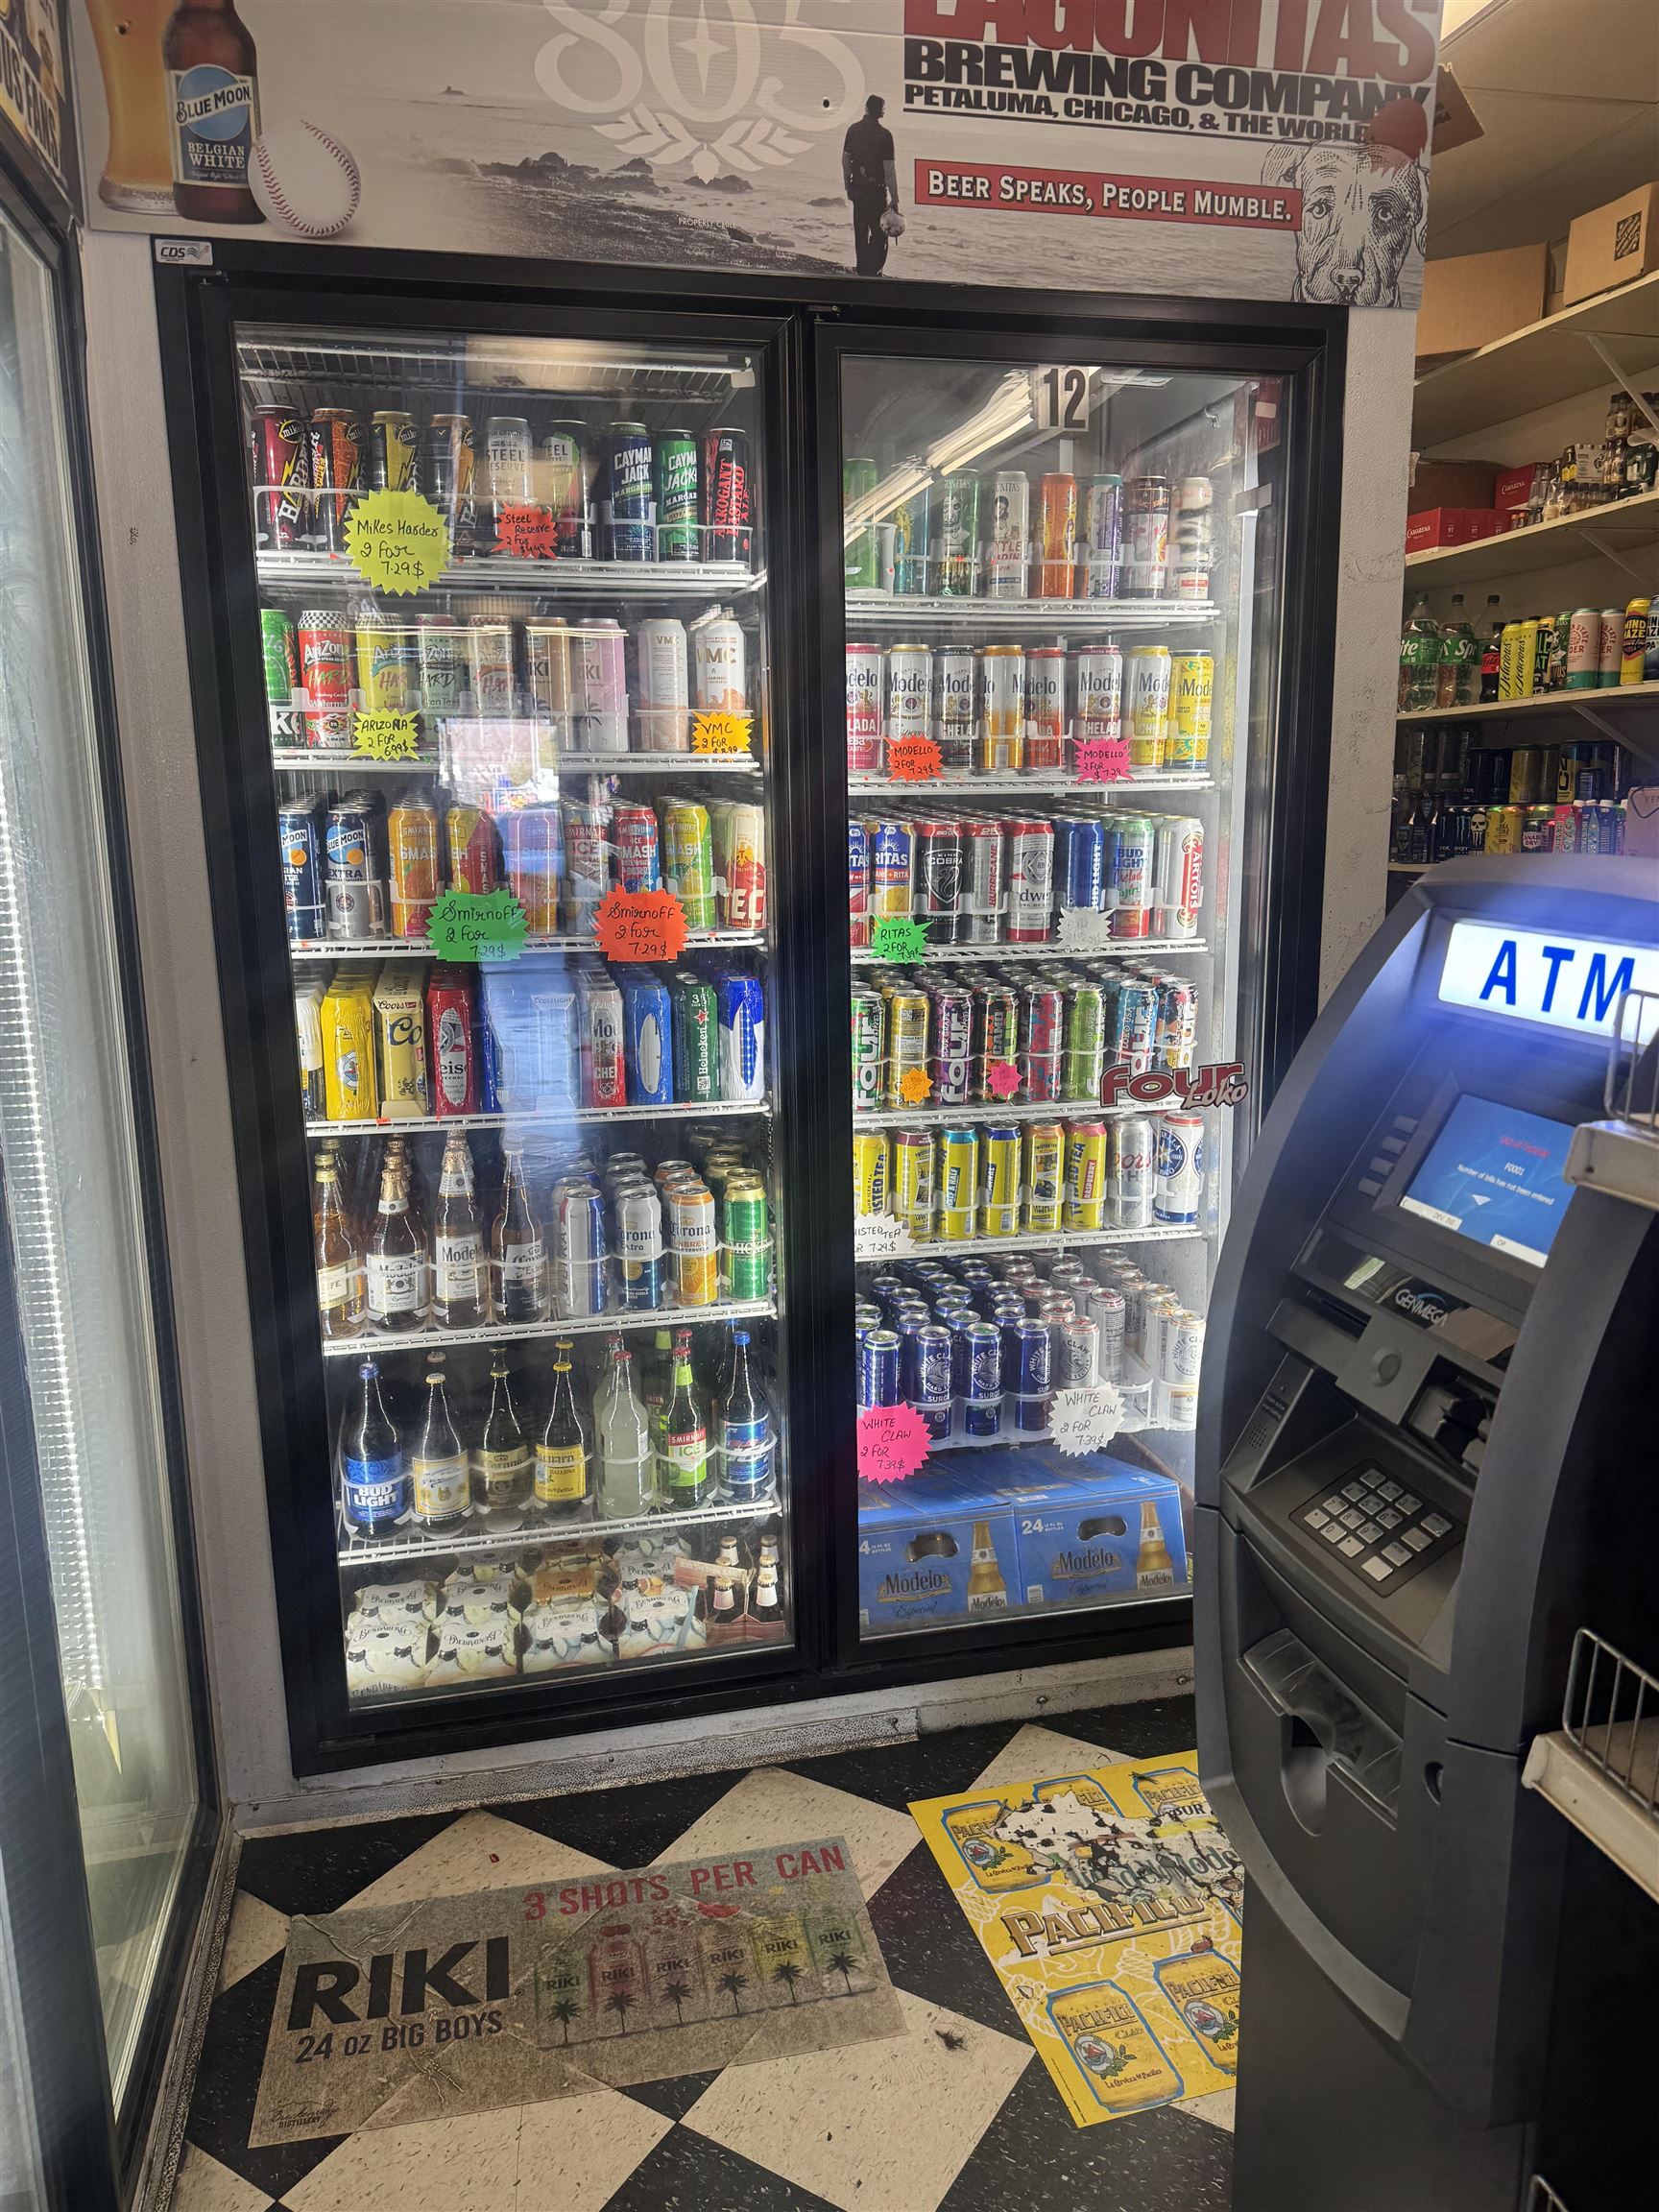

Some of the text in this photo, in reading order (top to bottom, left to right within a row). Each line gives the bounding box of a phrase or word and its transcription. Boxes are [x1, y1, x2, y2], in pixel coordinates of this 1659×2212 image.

[904, 37, 1167, 102] BREWING
[176, 84, 252, 124] BLUE MOON
[905, 84, 1059, 118] PETALUMA,
[1064, 97, 1194, 131] CHICAGO,
[1199, 112, 1220, 131] &
[1223, 111, 1274, 135] THE
[187, 141, 245, 156] BELGIAN
[189, 153, 246, 169] WHITE
[927, 169, 1293, 222] BEER SPEAKS, PEOPLE MUMBLE.
[160, 247, 185, 259] CDS
[1044, 369, 1086, 428] 12
[361, 718, 408, 733] ARIZONA
[701, 722, 733, 734] VMC
[367, 733, 395, 749] 2 FOR
[328, 868, 363, 878] EXTRA
[988, 844, 998, 907] HURRICANE
[880, 929, 912, 941] RITAS
[883, 942, 908, 953] 2 FOR
[1479, 939, 1636, 1023] ATM
[378, 1000, 404, 1010] Coors
[697, 1026, 709, 1075] Heineken
[1457, 1163, 1478, 1177] Number
[1394, 1287, 1449, 1328] GENMEGA
[1066, 1392, 1100, 1407] WHITE
[1089, 1405, 1117, 1417] CLAW
[863, 1417, 896, 1431] WHITE
[1072, 1420, 1091, 1433] FOR
[880, 1431, 912, 1443] CLAW
[872, 1444, 890, 1458] FOR
[353, 1492, 397, 1506] LIGHT
[1059, 1549, 1113, 1574] Modelo
[886, 1570, 943, 1596] Modelo
[522, 1845, 846, 1921] 3 SHOTS PER CAN
[818, 1930, 852, 1945] RIKI
[710, 1949, 745, 1964] RIKI
[601, 1968, 636, 1983] RIKI
[287, 1936, 510, 2031] RIKI
[296, 2034, 333, 2064] 24
[380, 2023, 424, 2052] BIG
[436, 2010, 503, 2044] BOYS
